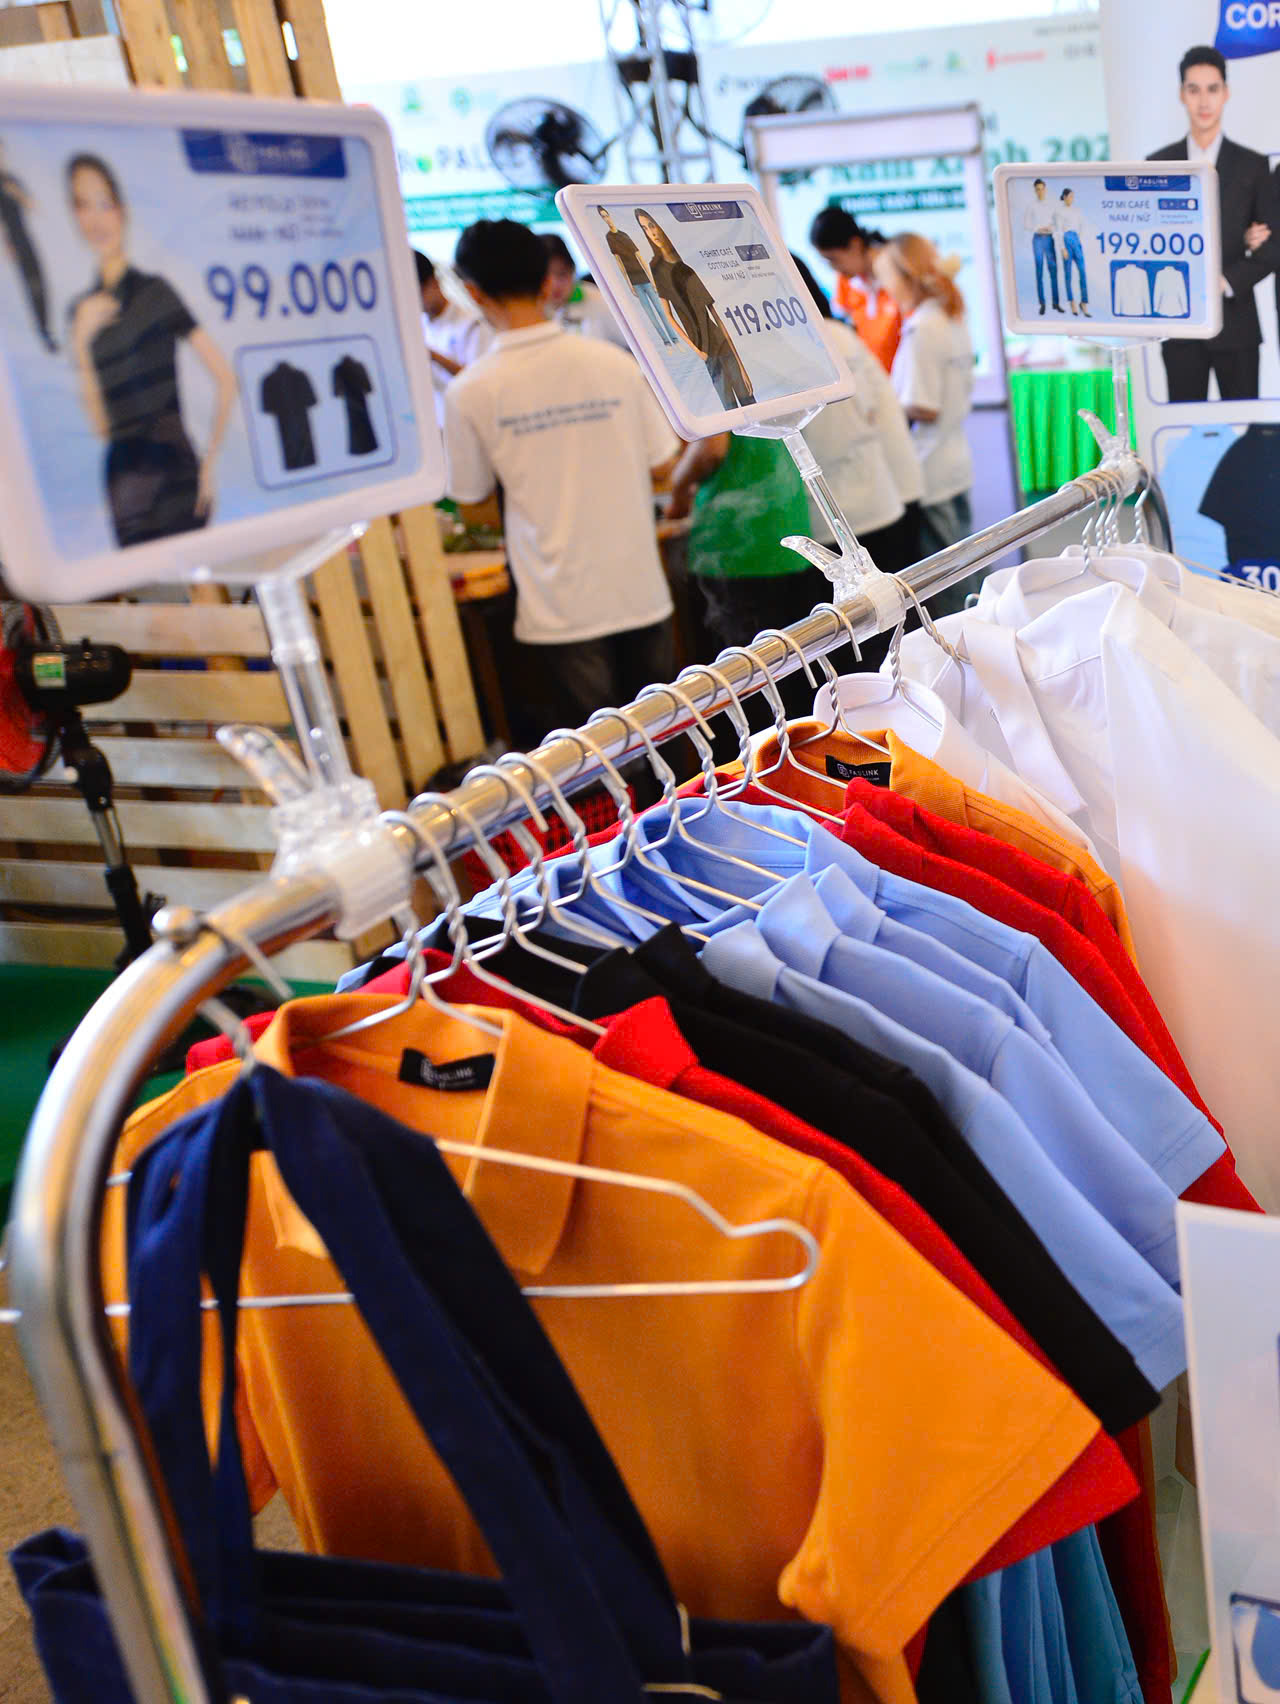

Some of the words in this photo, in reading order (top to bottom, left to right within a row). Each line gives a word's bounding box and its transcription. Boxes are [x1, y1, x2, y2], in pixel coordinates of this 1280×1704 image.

[1096, 231, 1205, 256] 199.000
[206, 260, 378, 322] 99.000
[724, 296, 808, 337] 119.000
